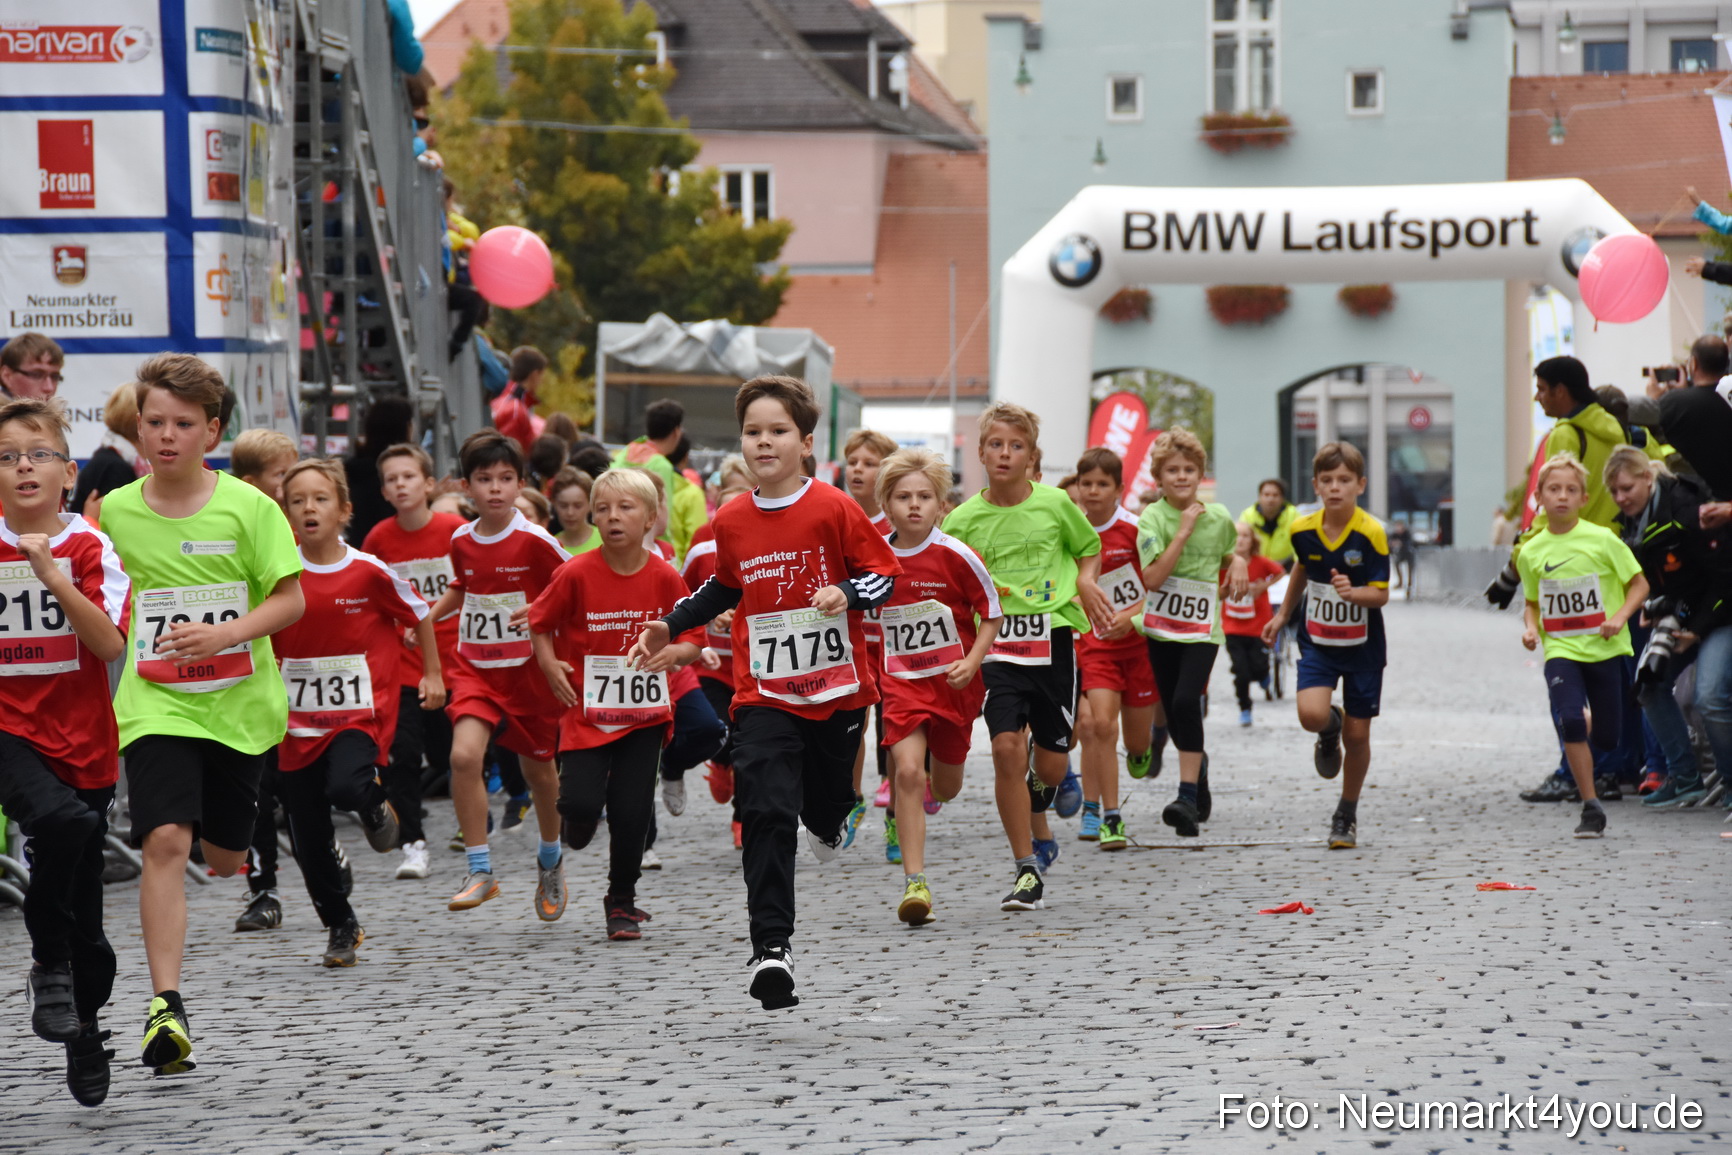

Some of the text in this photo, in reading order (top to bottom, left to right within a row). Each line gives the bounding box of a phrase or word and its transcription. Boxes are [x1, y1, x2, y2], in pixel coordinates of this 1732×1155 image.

[37, 168, 91, 193] Braun
[1124, 208, 1541, 259] BMW Laufsport
[26, 293, 118, 307] Neumarkter
[10, 309, 133, 328] Lammsbräu
[740, 551, 798, 571] Neumarkter
[141, 600, 177, 608] NeuerMarkt
[182, 586, 239, 603] BOCK
[1544, 588, 1599, 615] 7084
[1155, 590, 1209, 621] 7059
[1313, 596, 1362, 623] 7000
[586, 610, 643, 621] Neumarkter
[587, 621, 632, 631] Stadtlauf
[755, 622, 786, 632] NeuerMarkt
[886, 616, 950, 652] 7221
[244, 643, 248, 651] K
[758, 627, 845, 674] 7179
[909, 654, 940, 669] Julius
[177, 664, 215, 679] Leon
[290, 675, 361, 708] 7131
[594, 674, 661, 704] 7166
[786, 676, 828, 695] Quirin
[596, 711, 661, 723] Maximilian
